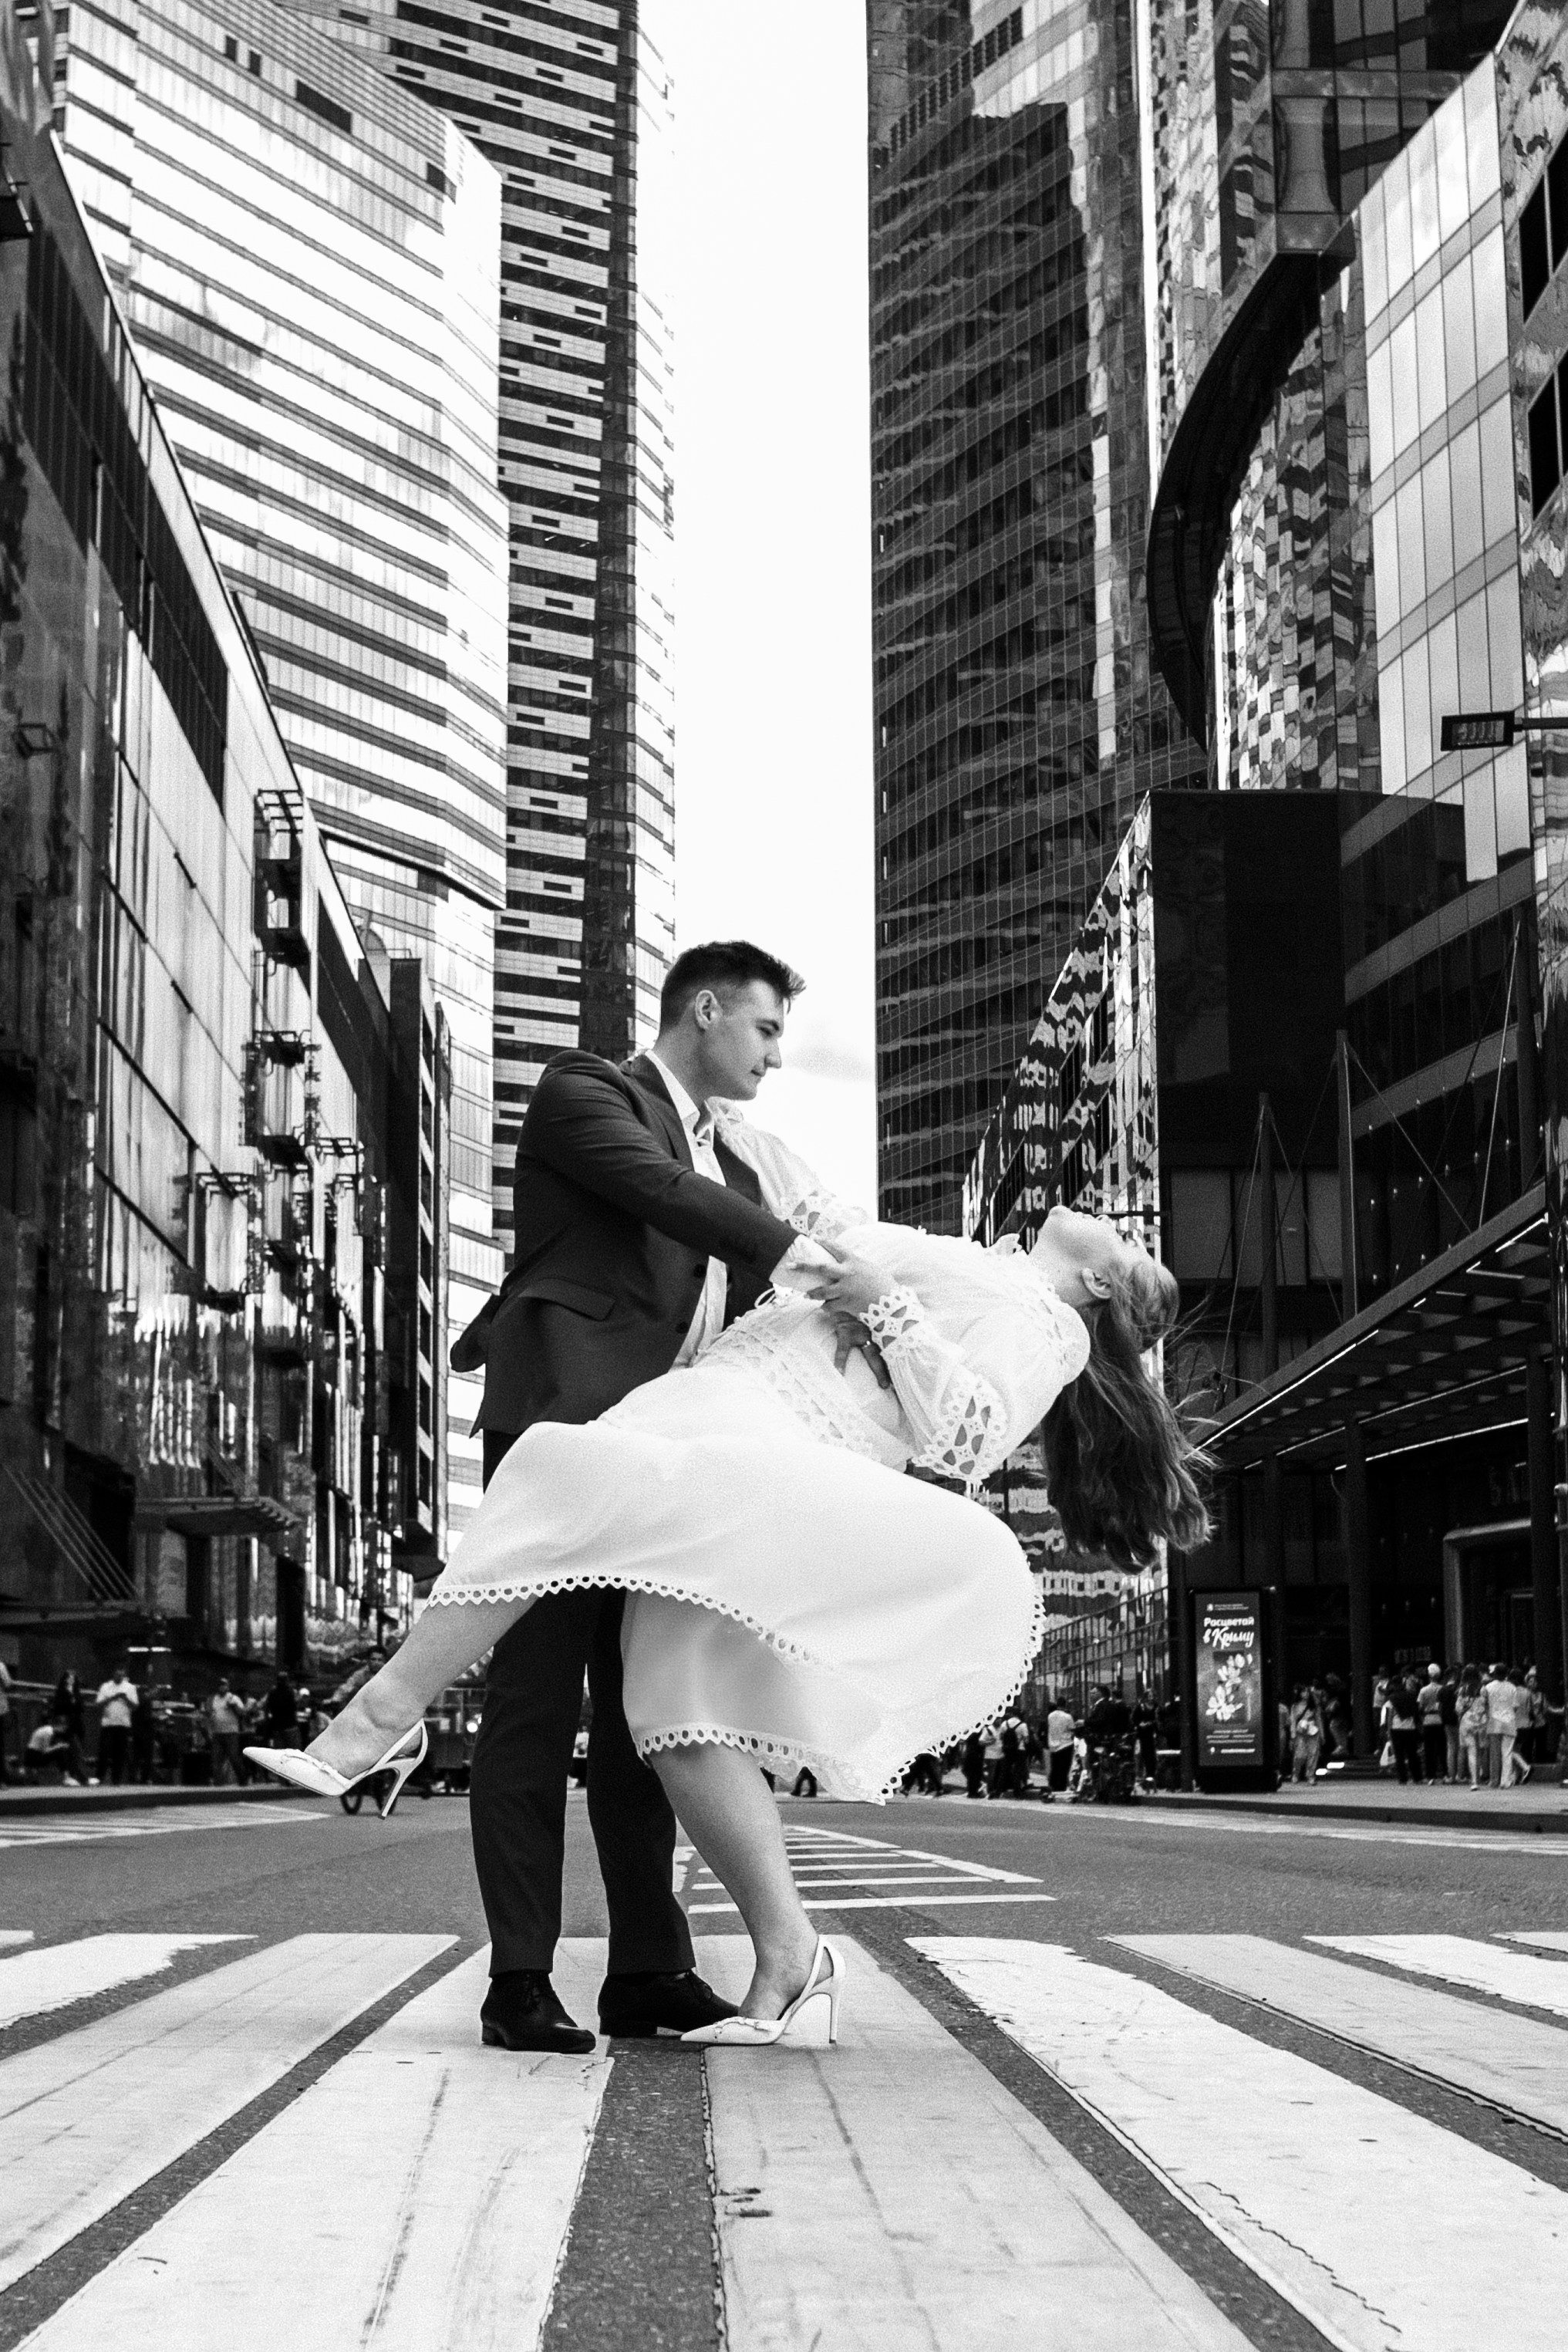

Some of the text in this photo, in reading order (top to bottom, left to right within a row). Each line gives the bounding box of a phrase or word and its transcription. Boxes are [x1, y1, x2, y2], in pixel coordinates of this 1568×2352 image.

[1204, 1616, 1254, 1627] Расцветай
[1202, 1626, 1254, 1649] в Крыму
